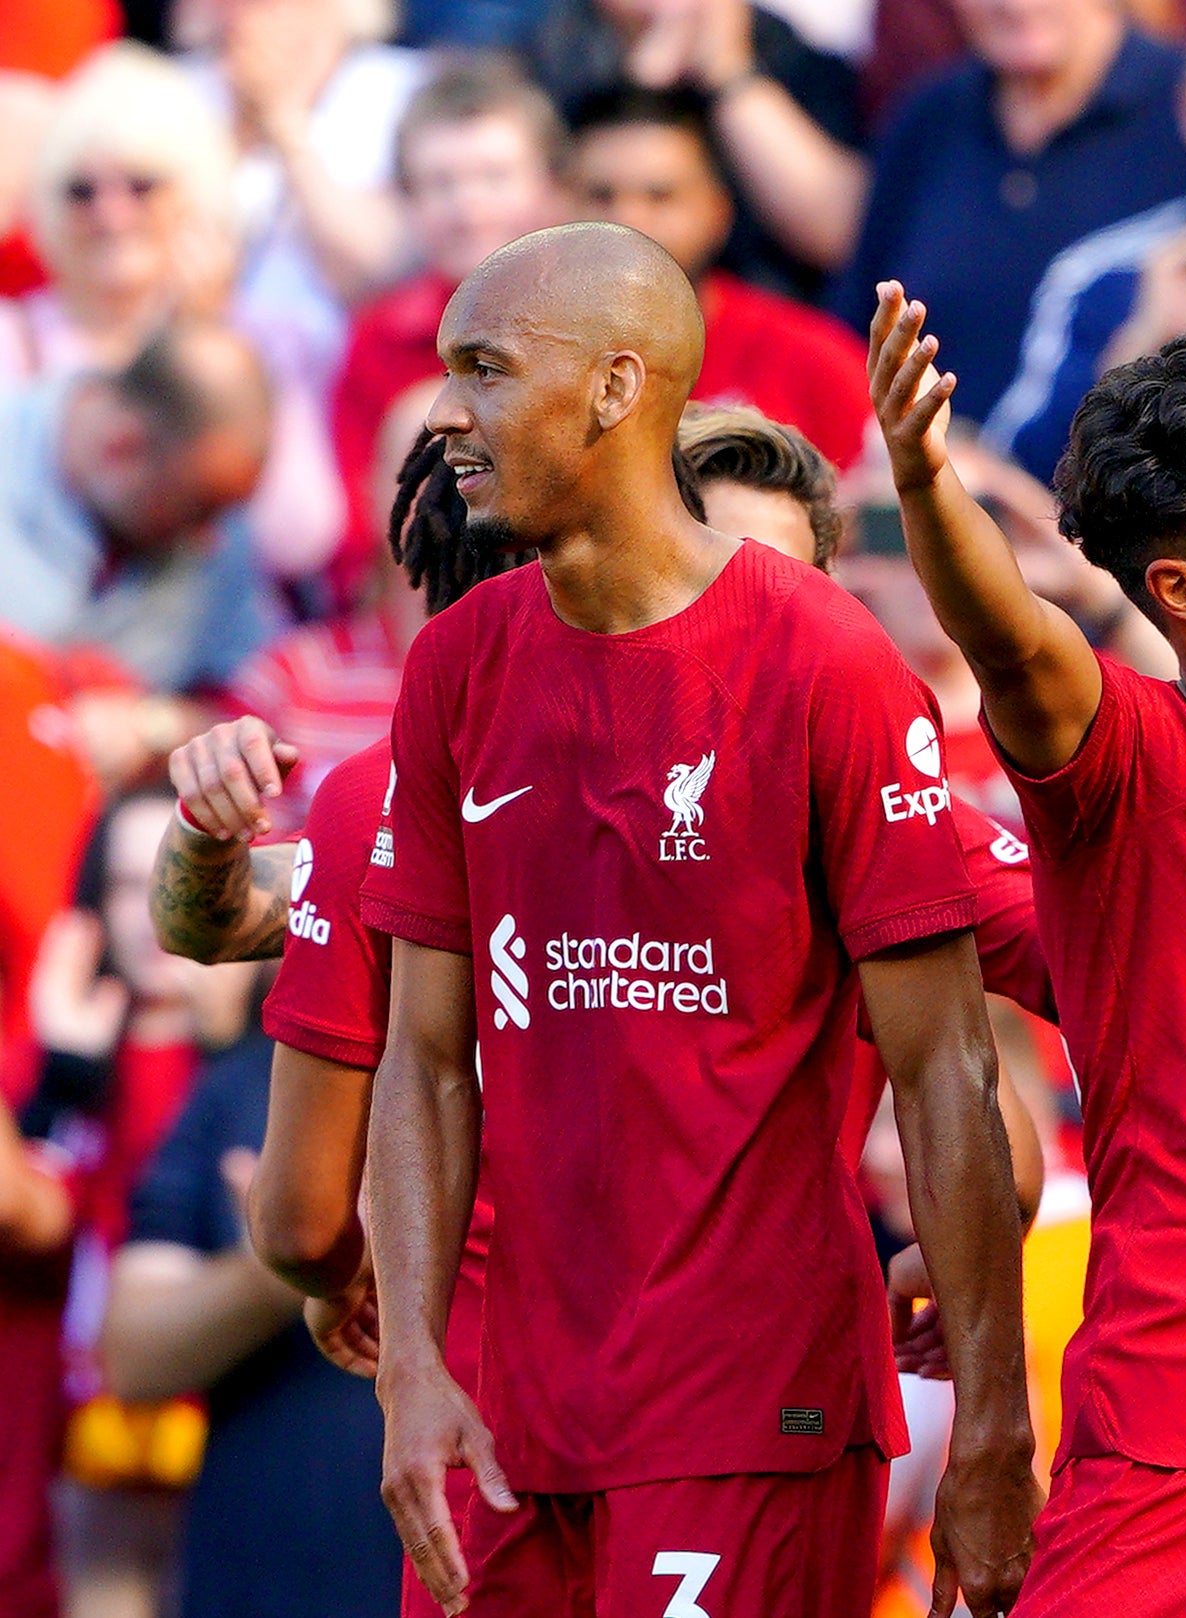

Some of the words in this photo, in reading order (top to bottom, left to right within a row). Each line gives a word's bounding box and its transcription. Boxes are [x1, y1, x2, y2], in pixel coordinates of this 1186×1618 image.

[880, 777, 951, 826] Exp
[658, 838, 711, 861] L.F.C.
[288, 900, 331, 946] dia
[546, 931, 714, 975] standard
[651, 1551, 721, 1618] 3
